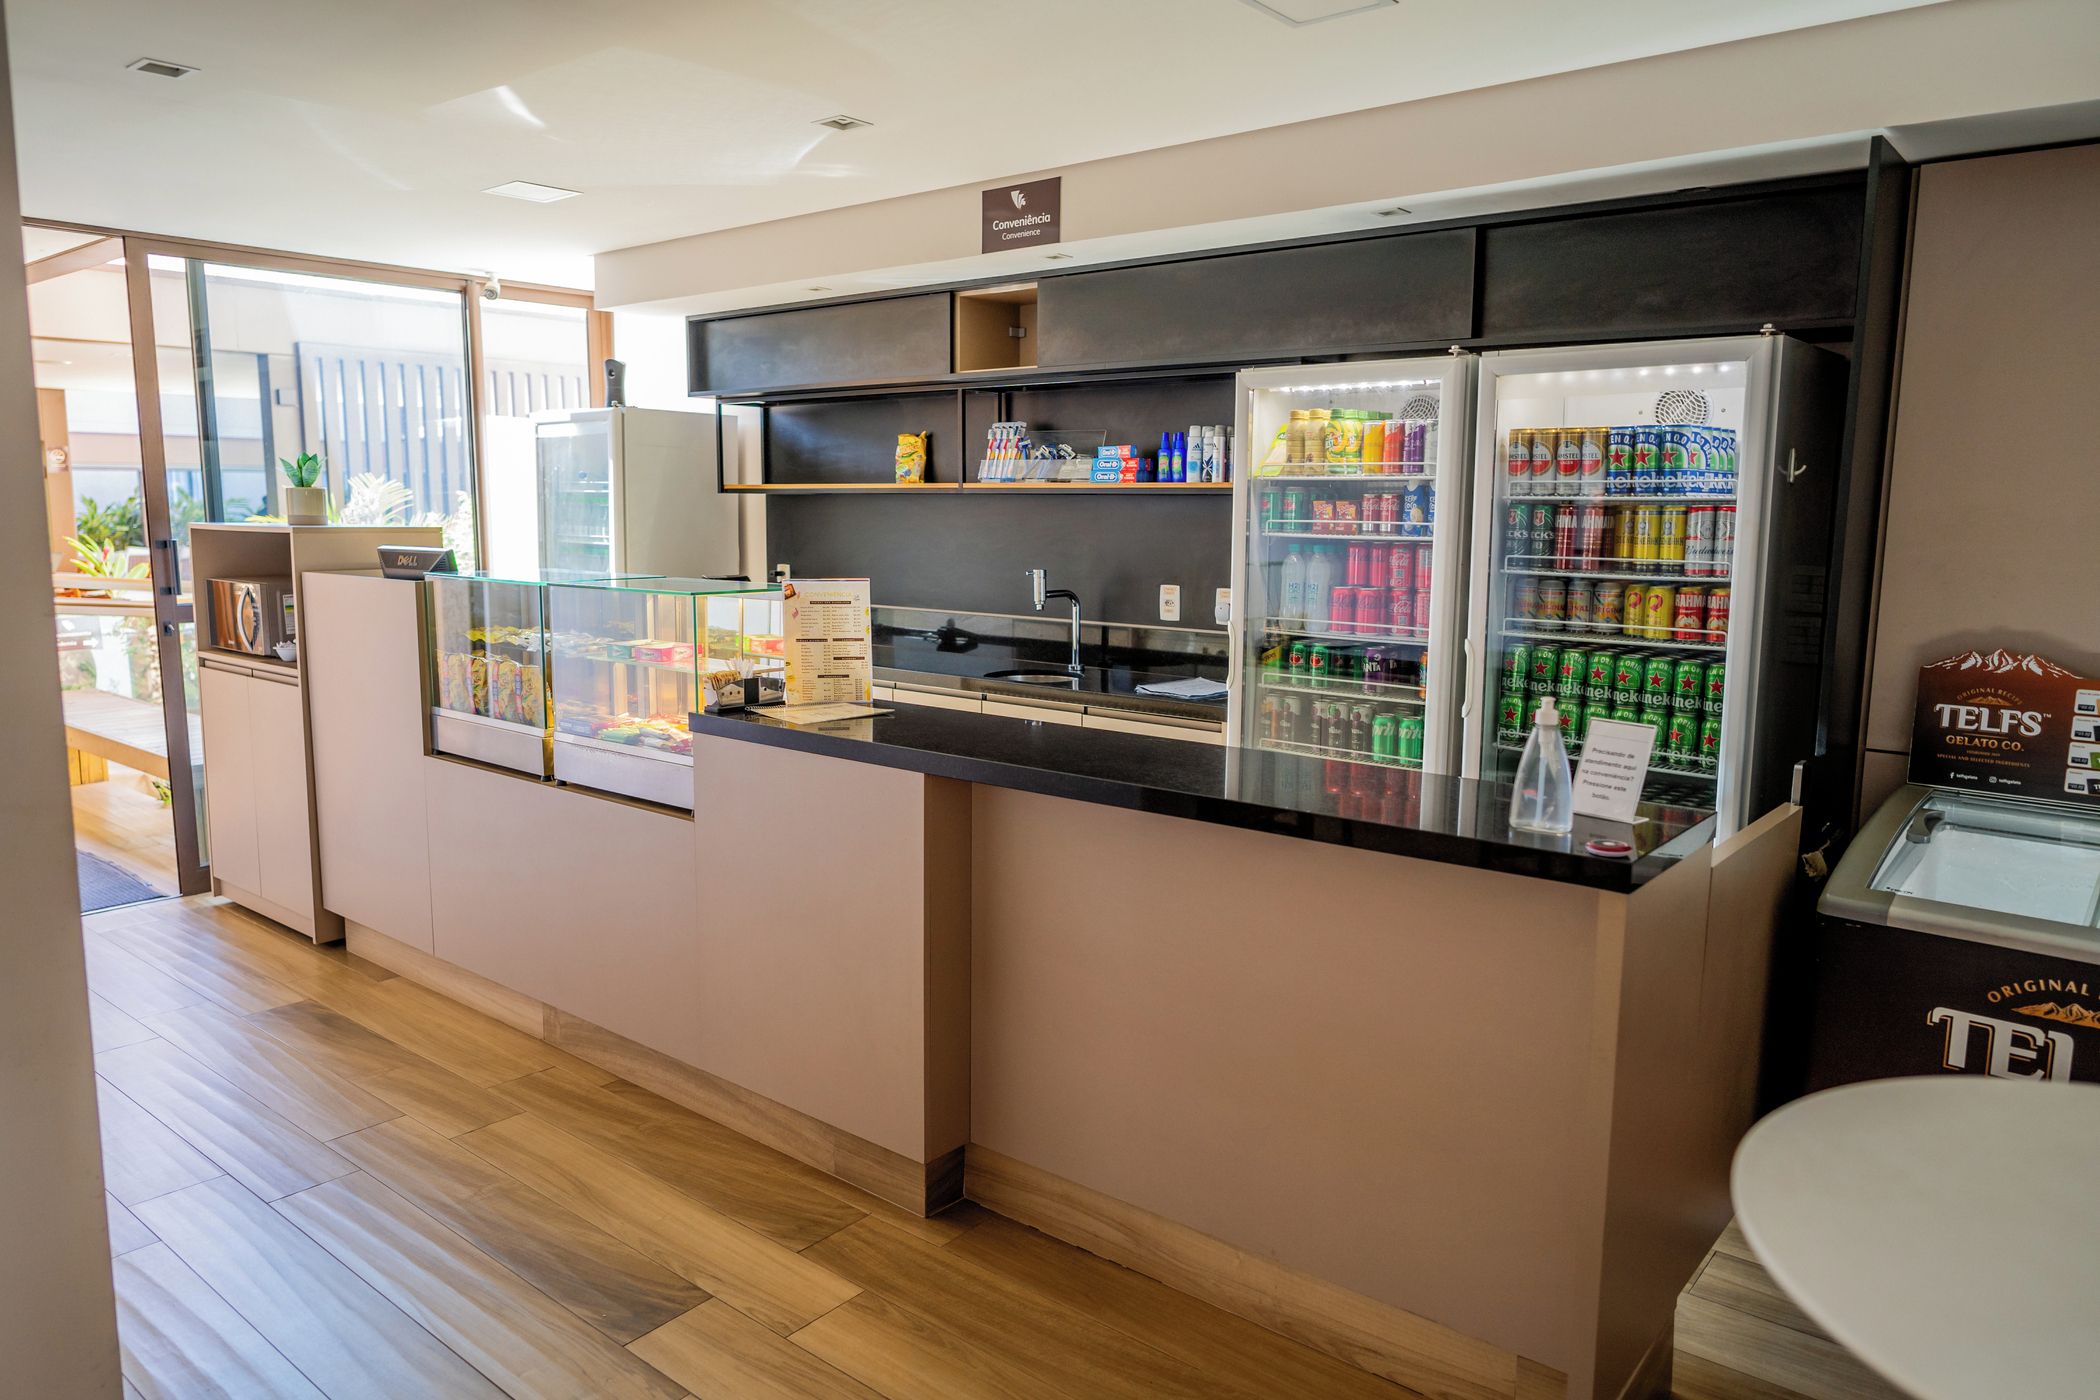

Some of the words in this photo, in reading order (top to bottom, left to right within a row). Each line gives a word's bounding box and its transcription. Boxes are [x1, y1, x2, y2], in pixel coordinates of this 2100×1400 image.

[992, 212, 1051, 230] Conveniência
[1002, 229, 1040, 240] Convenience
[398, 554, 418, 567] DELL
[1935, 703, 2042, 736] TELFS
[1946, 734, 1998, 749] GELATO
[2002, 740, 2025, 752] CO.
[1987, 978, 2090, 1004] ORIGINAL
